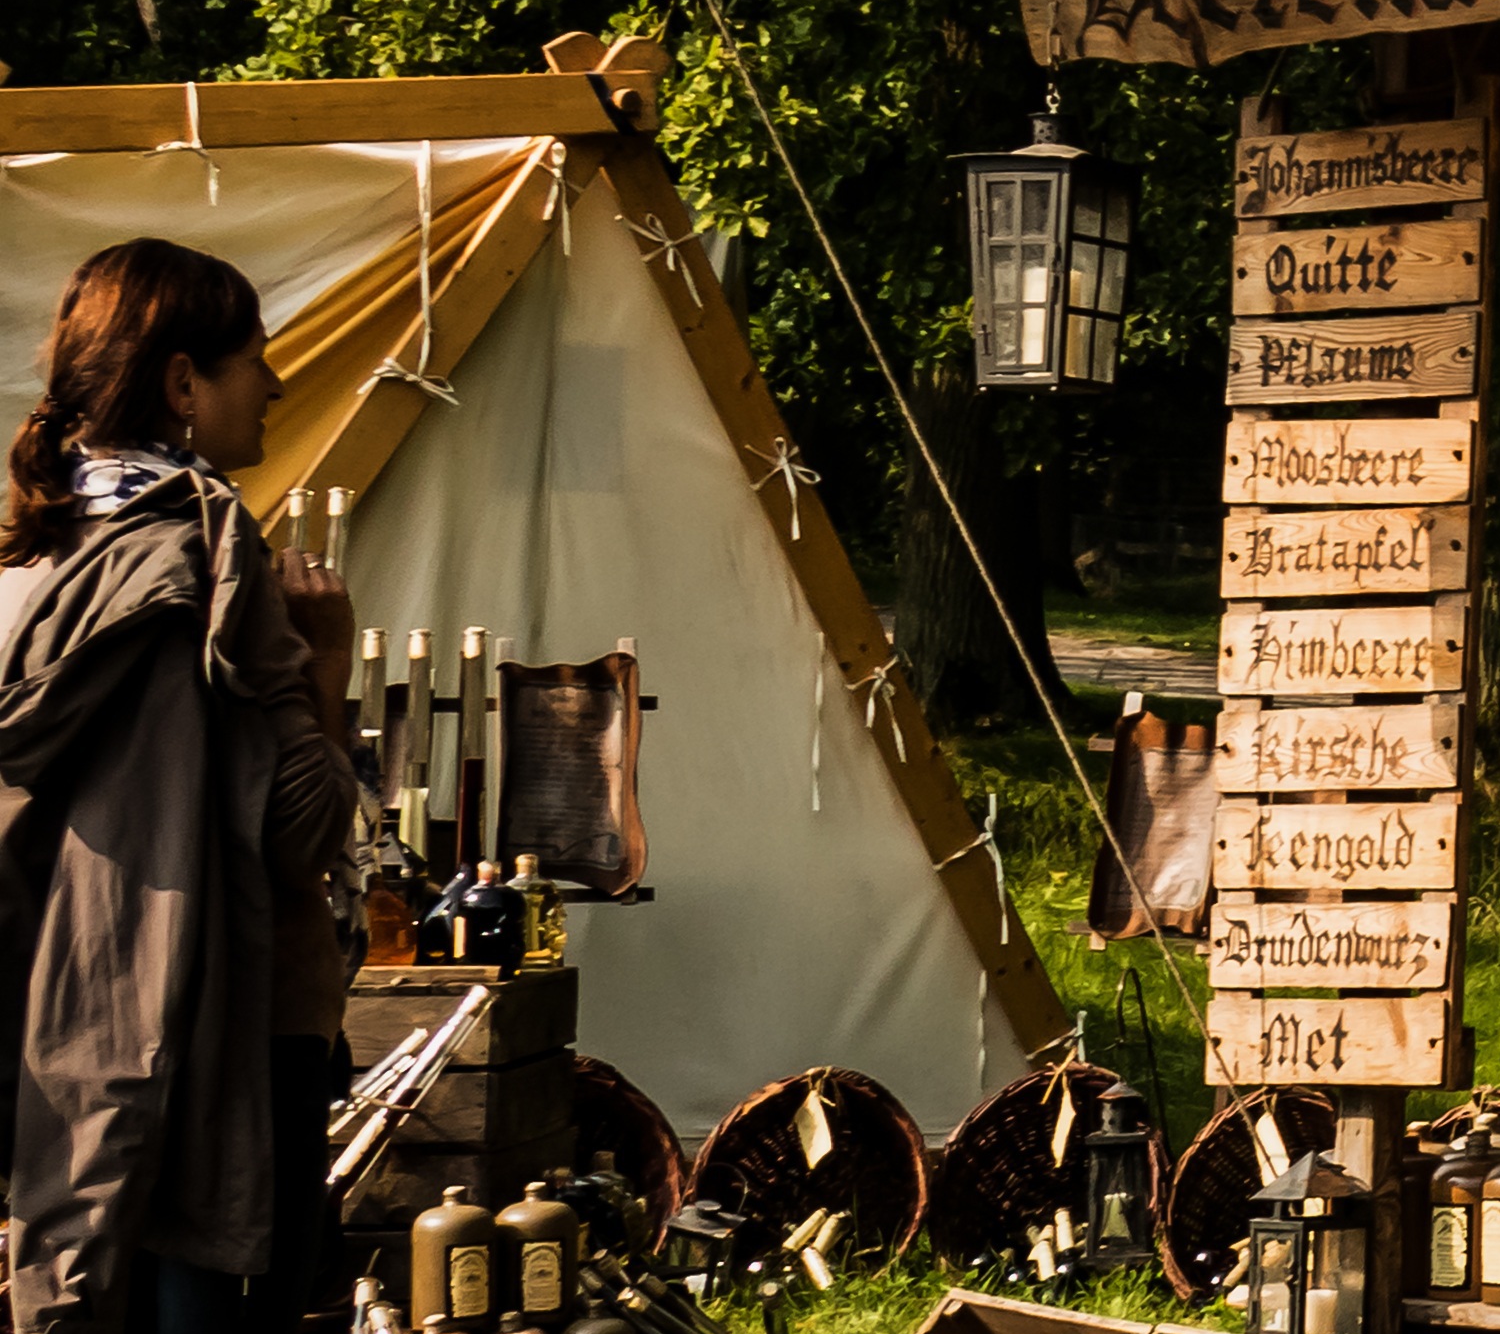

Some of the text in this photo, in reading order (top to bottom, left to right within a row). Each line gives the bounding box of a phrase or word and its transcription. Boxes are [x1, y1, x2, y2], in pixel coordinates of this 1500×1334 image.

[1266, 235, 1398, 295] Quitte
[1258, 336, 1414, 388] Pflaume
[1243, 424, 1426, 492] Moosbeere
[1242, 521, 1430, 588] Bratapfel
[1245, 619, 1431, 691] Himbeere
[1251, 715, 1408, 786] Kirsche
[1244, 808, 1414, 881] Feengold
[1221, 911, 1431, 984] Druidenwurz
[1261, 1010, 1350, 1071] Met
